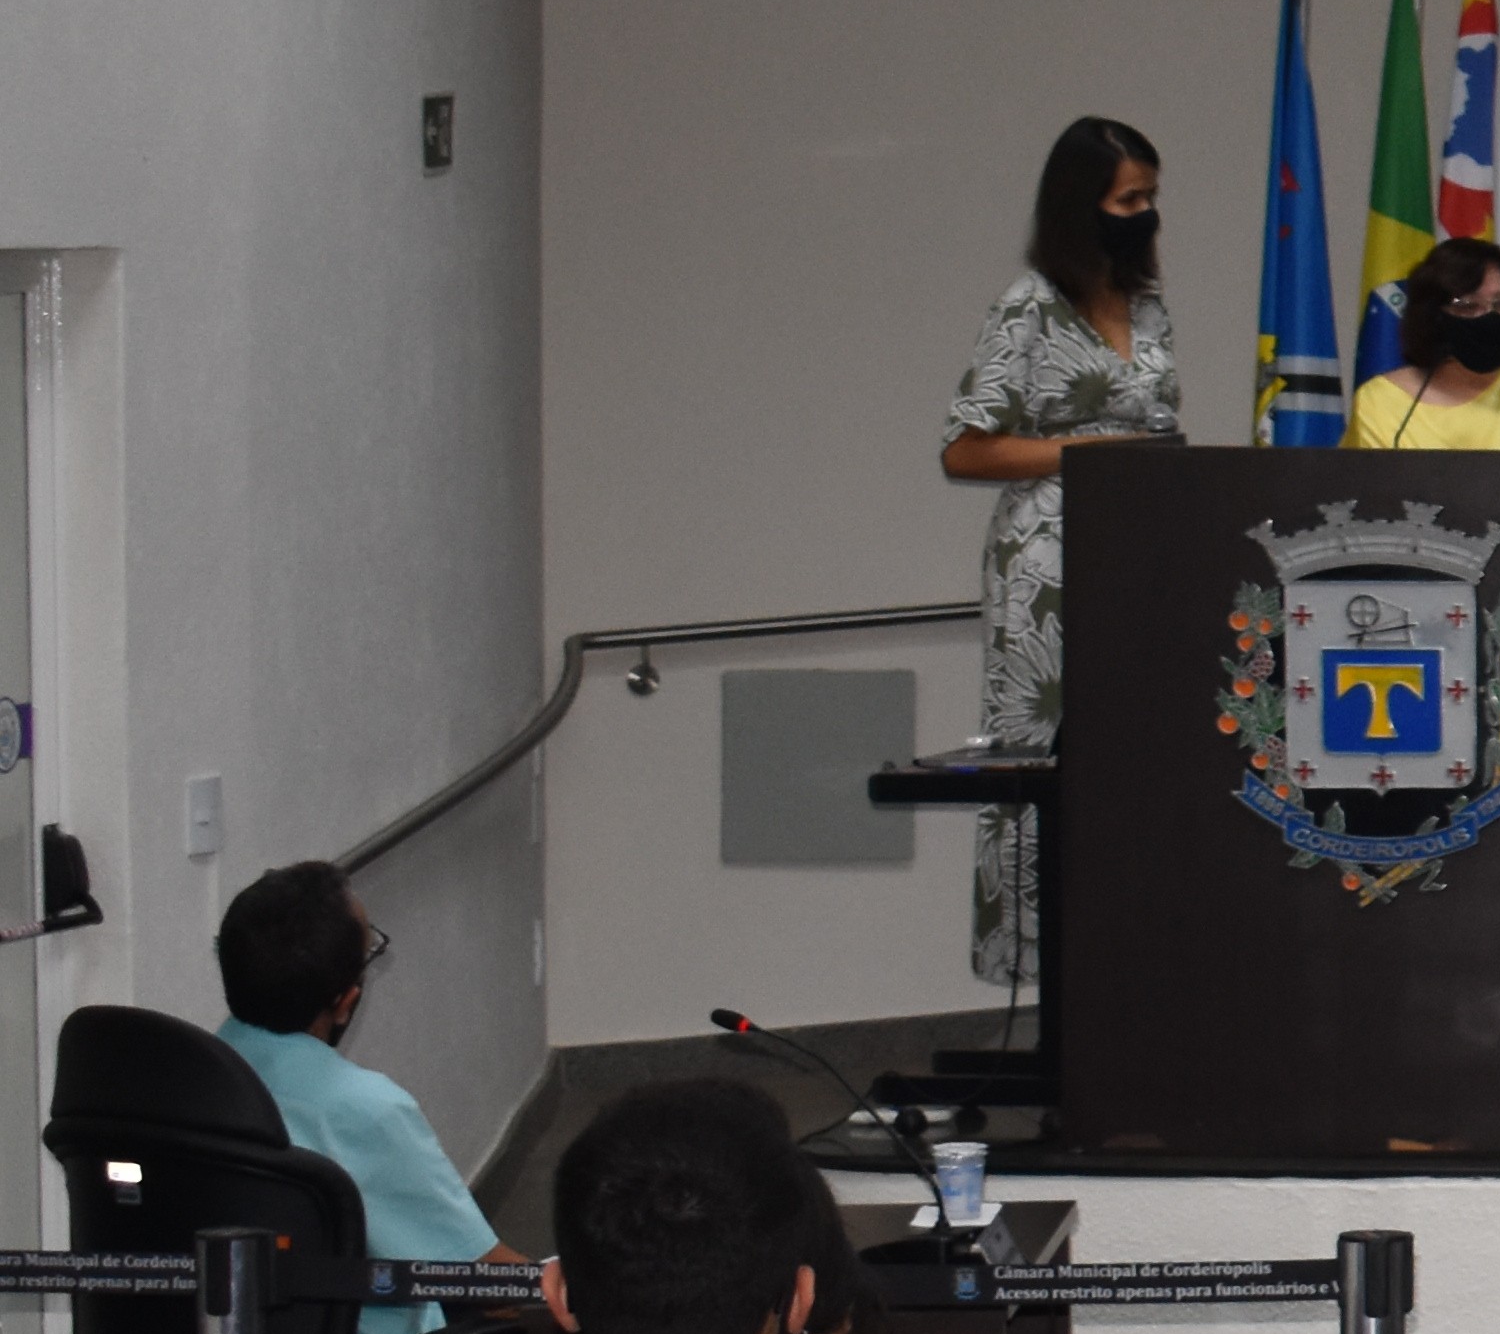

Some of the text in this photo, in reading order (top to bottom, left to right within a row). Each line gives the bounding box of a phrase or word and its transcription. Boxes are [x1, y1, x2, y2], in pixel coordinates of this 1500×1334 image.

[24, 1253, 99, 1270] Municipal
[103, 1254, 121, 1267] de
[411, 1261, 471, 1275] Câmara
[994, 1262, 1272, 1280] Câmara Municipal de Cordeirópolis
[19, 1276, 76, 1287] restrito
[79, 1276, 132, 1290] apenas
[135, 1278, 169, 1291] para
[411, 1283, 464, 1297] Acesso
[469, 1283, 528, 1297] restrito
[995, 1282, 1328, 1301] Acesso restrito apenas para funcionários e
